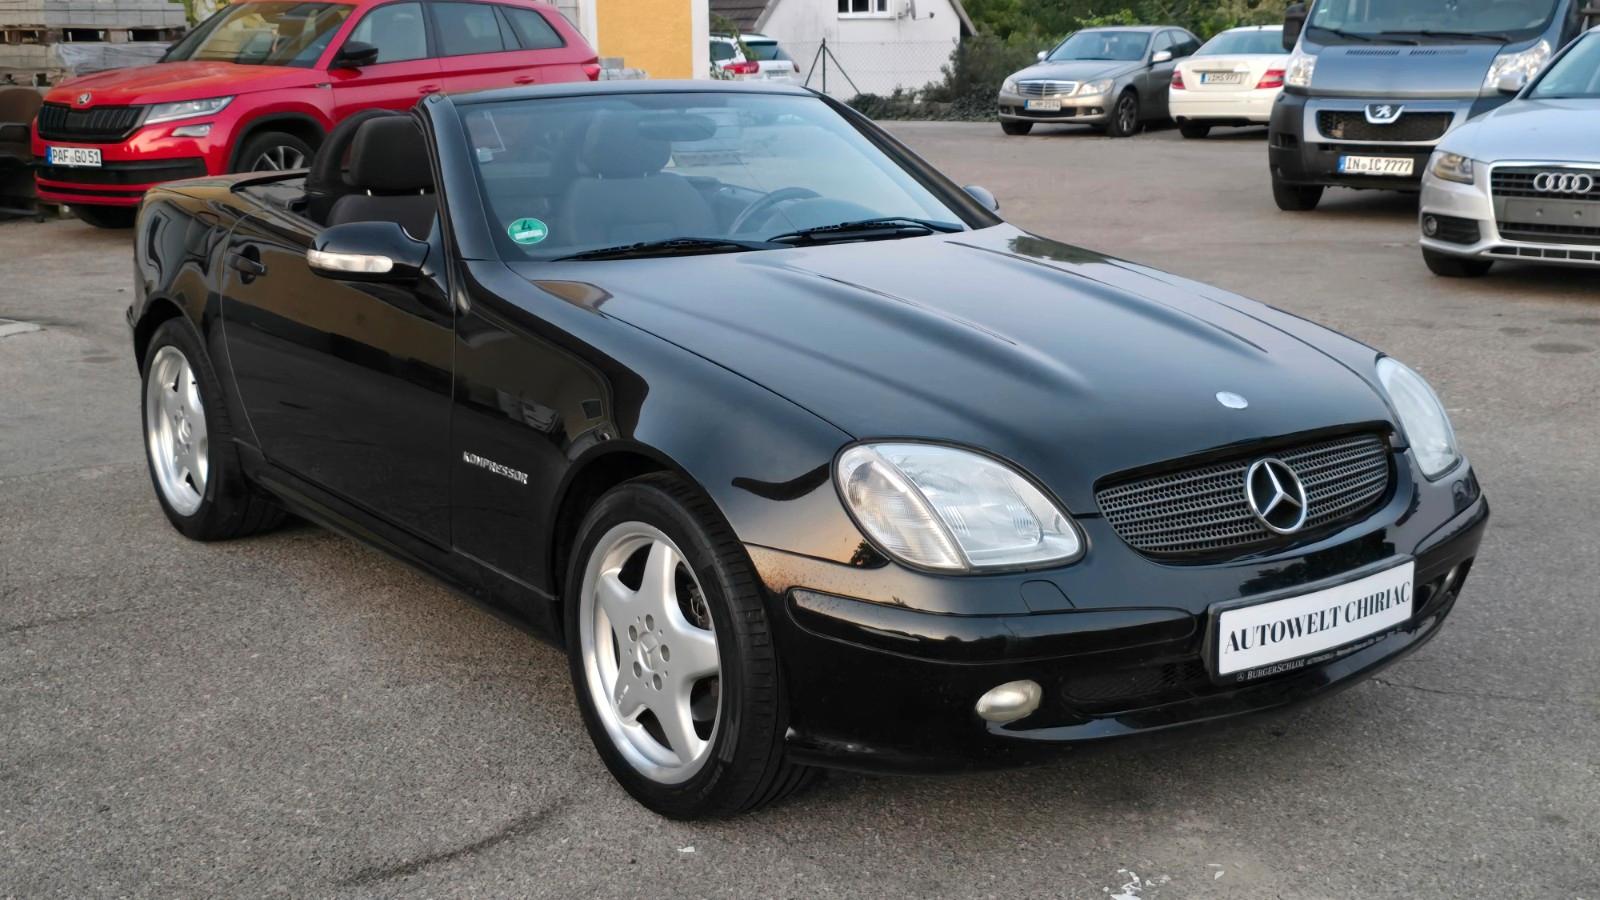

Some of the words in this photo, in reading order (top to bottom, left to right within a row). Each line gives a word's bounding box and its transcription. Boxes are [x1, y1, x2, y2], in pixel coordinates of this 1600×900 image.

[52, 148, 69, 161] PAF
[1347, 157, 1360, 170] IN
[1384, 159, 1412, 172] 7777
[521, 219, 532, 231] 4
[463, 450, 529, 485] KOMPRESSOR
[1224, 605, 1341, 654] AUTOWELT
[1344, 581, 1411, 624] CHIRIAC
